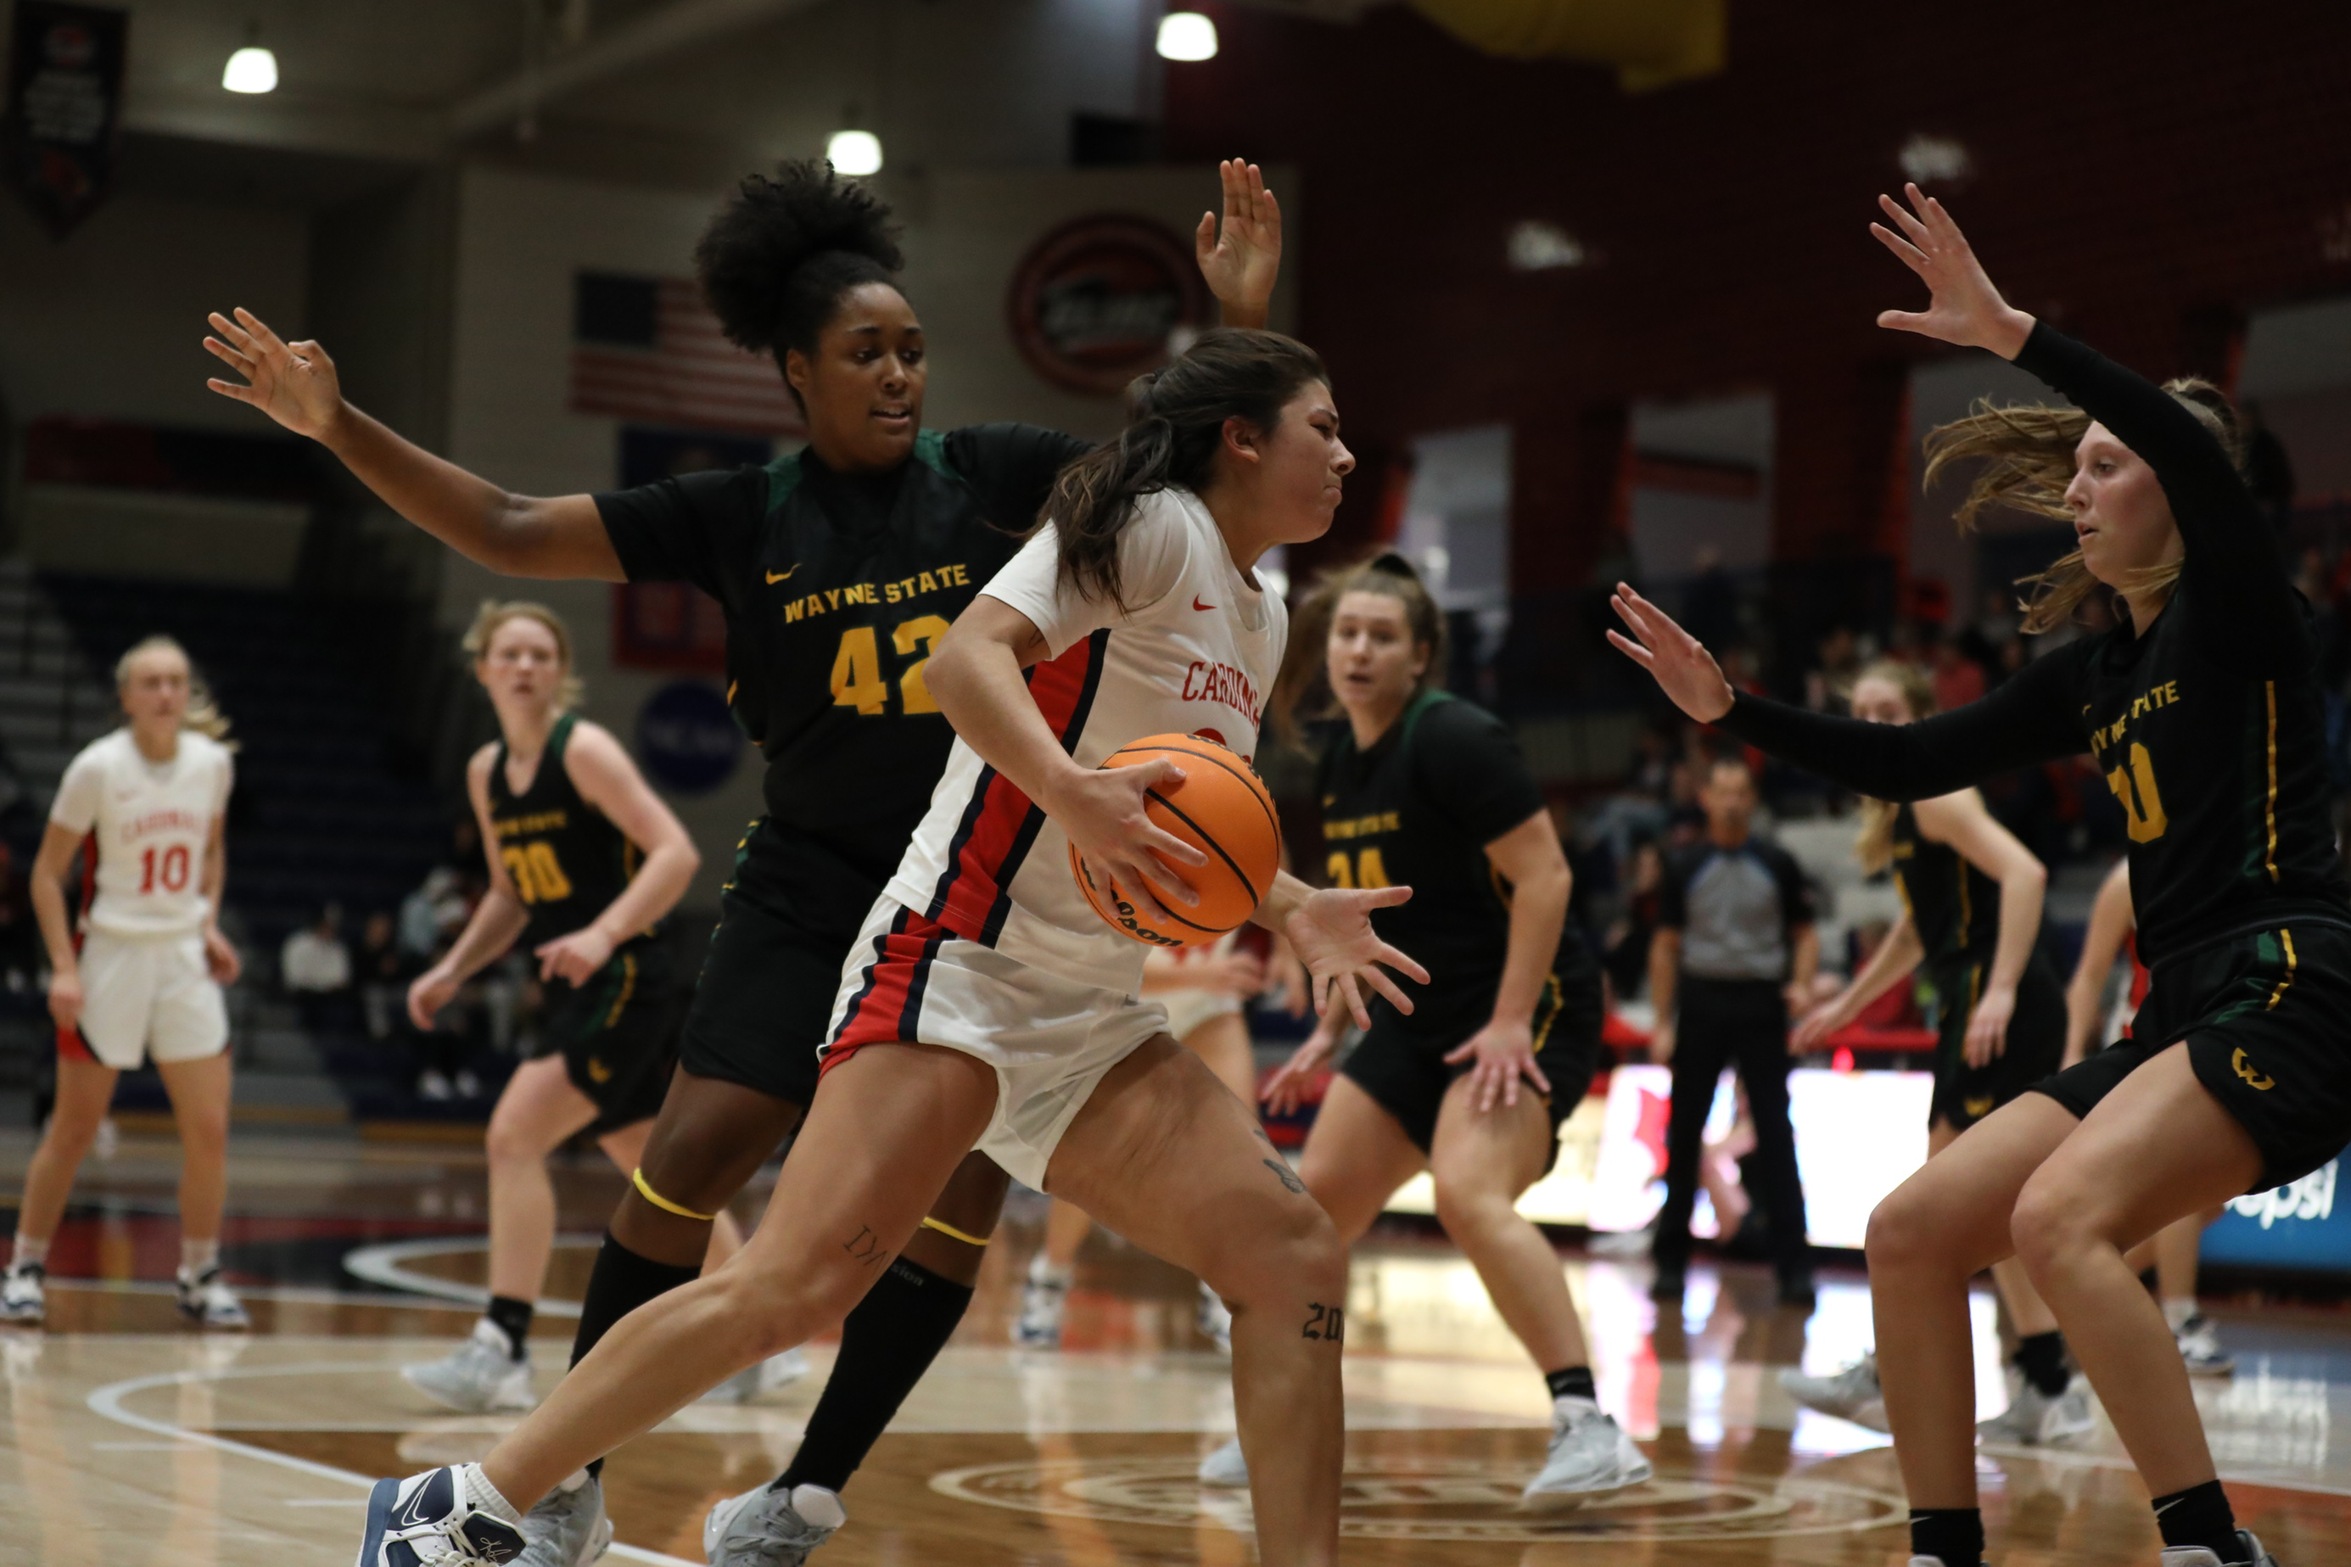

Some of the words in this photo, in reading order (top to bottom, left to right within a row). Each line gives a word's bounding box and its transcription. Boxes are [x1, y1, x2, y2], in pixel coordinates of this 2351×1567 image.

[784, 583, 880, 624] WAYNE
[884, 563, 972, 604] STATE
[829, 614, 952, 716] 42
[139, 845, 191, 895] 10
